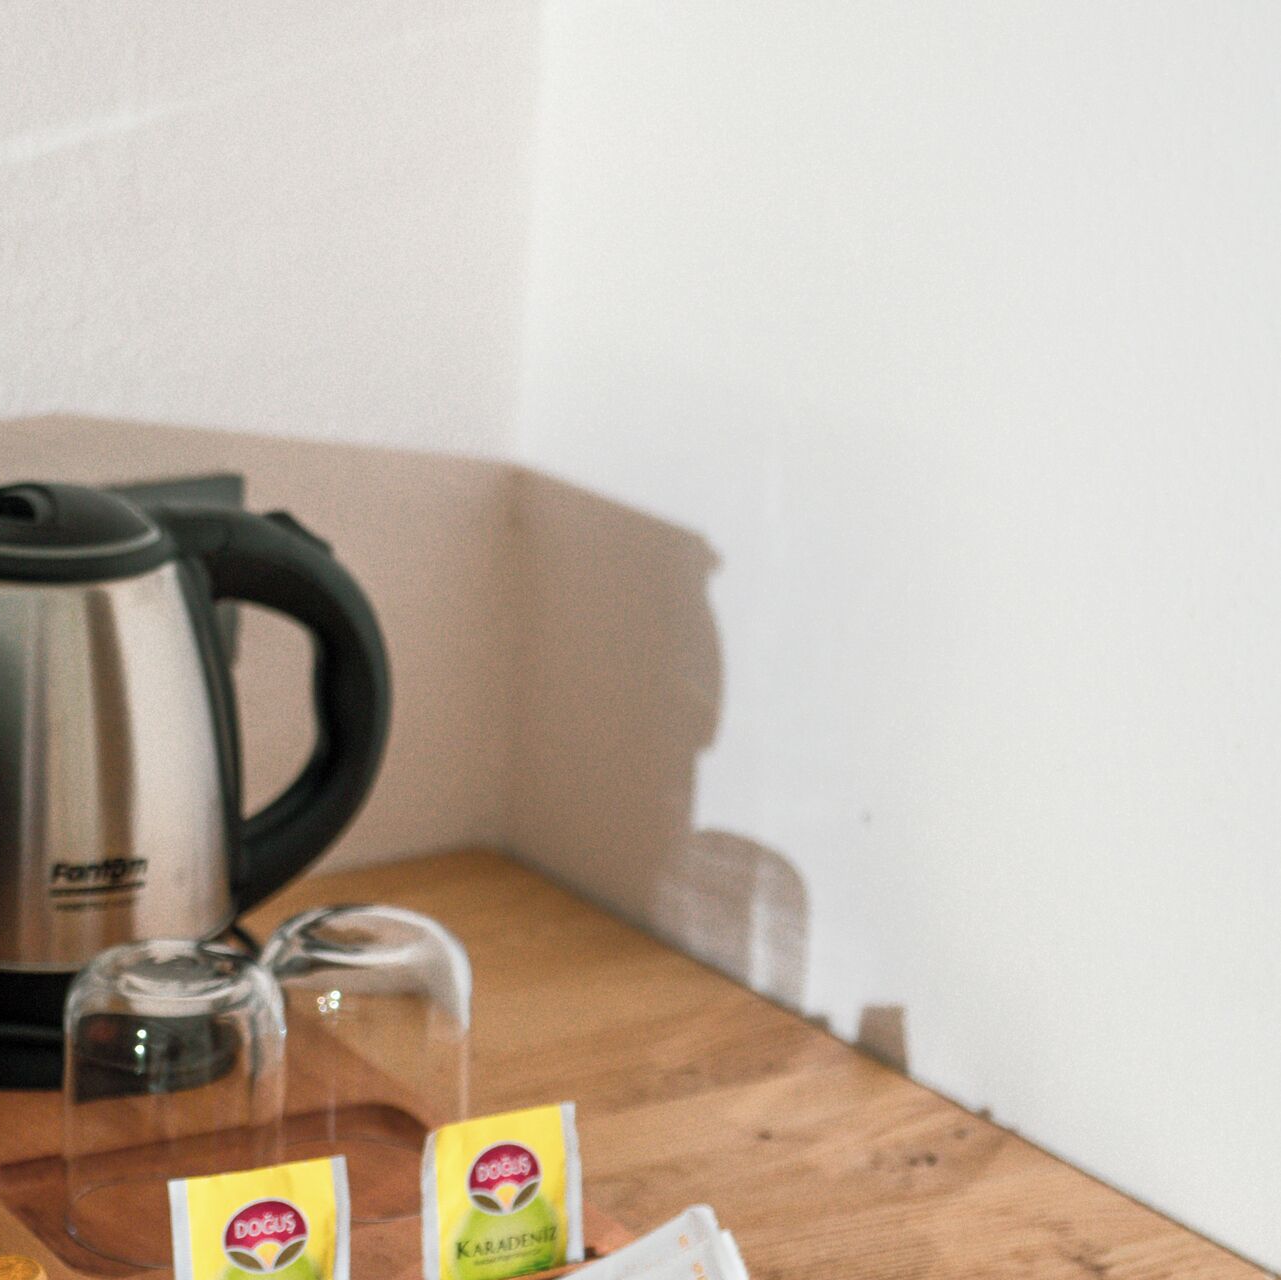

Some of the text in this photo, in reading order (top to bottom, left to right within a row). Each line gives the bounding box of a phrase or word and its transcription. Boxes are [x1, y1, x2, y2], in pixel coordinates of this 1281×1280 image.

[475, 1153, 532, 1183] DOĞUŞ
[234, 1212, 297, 1240] DOĞUŞ
[456, 1226, 558, 1260] KARADENİZ
